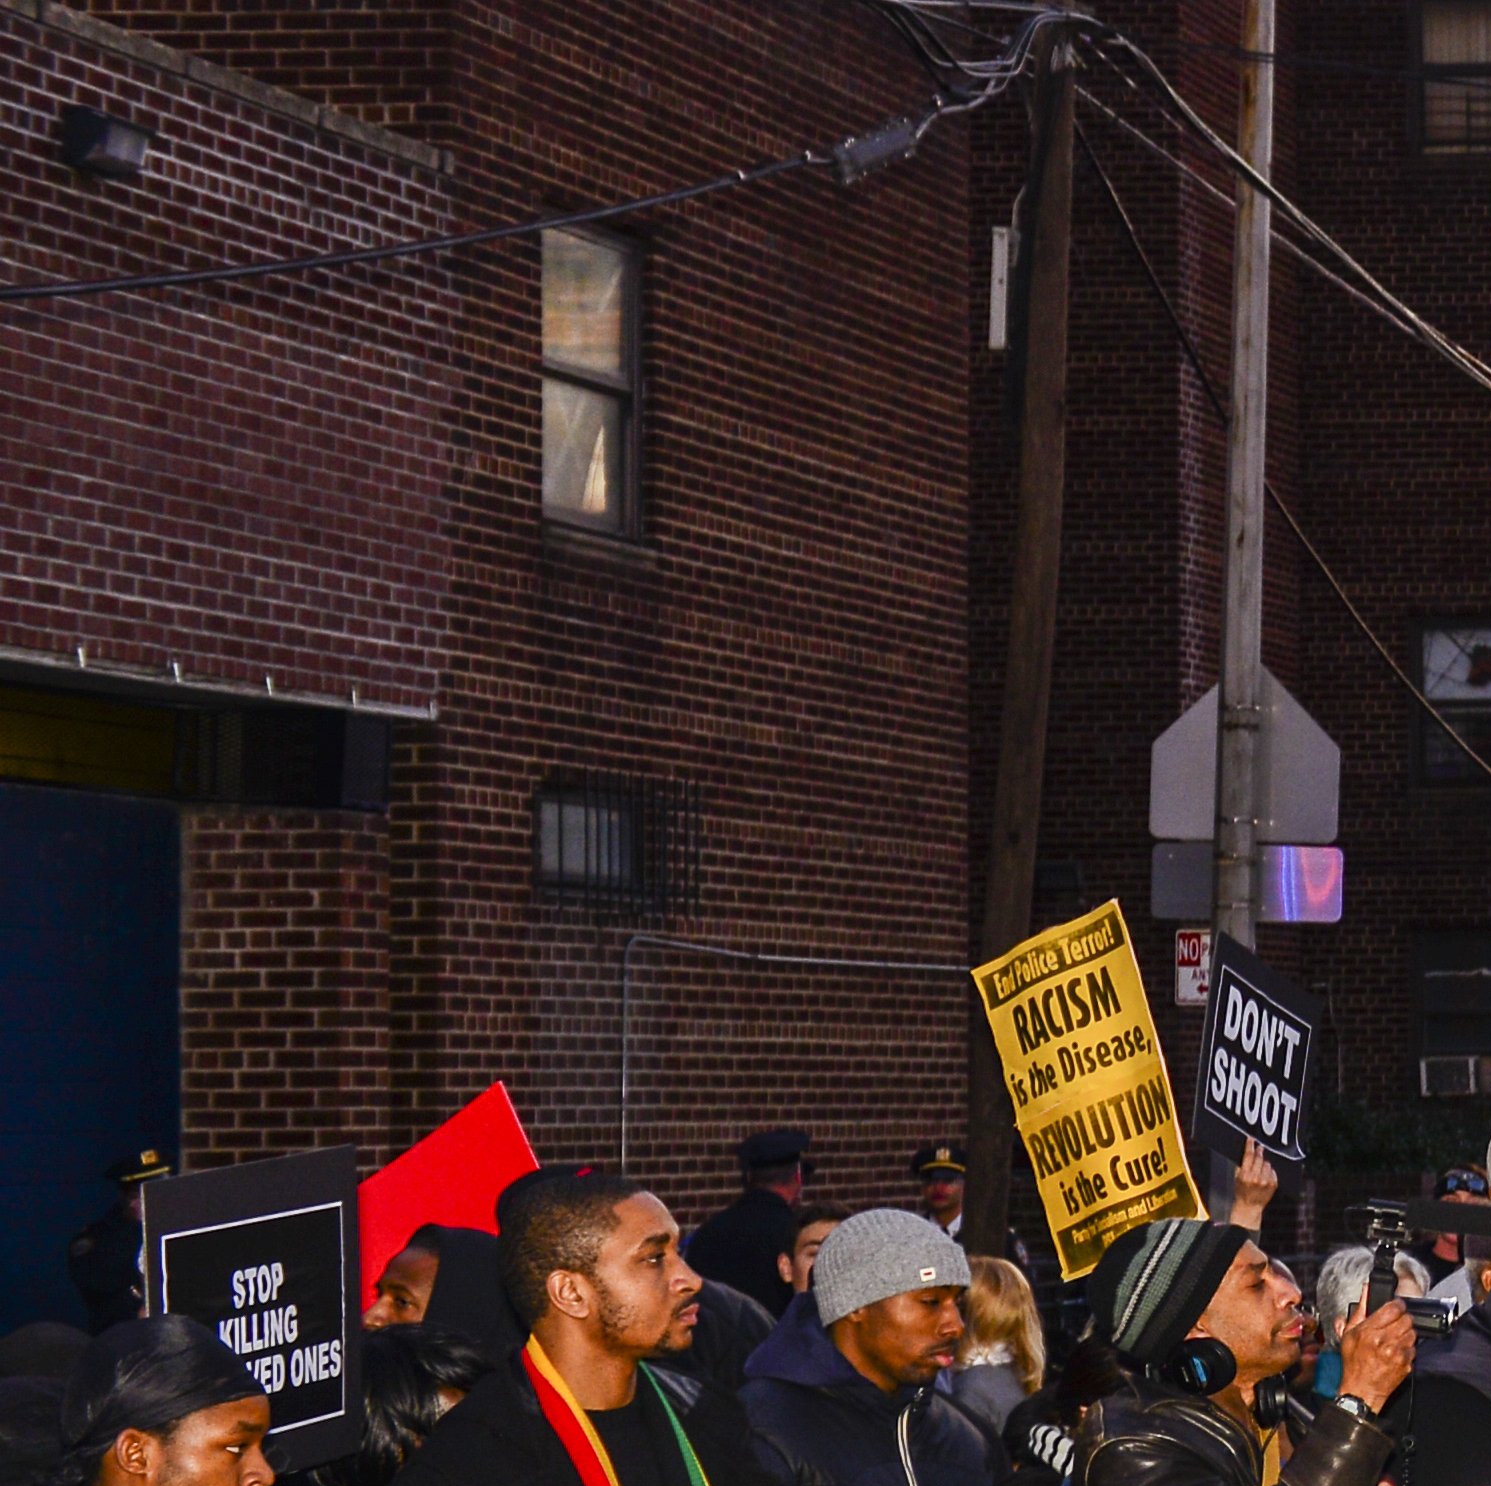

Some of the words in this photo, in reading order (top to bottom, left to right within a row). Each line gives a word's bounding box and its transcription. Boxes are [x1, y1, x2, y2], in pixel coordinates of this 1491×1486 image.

[1015, 949, 1059, 987] Police
[1058, 918, 1115, 965] Terror!
[1178, 937, 1199, 963] NO
[1012, 965, 1122, 1056] RACISM
[1224, 984, 1300, 1079] DON'T
[1010, 1073, 1027, 1108] is
[1028, 1061, 1058, 1099] the
[1056, 1025, 1152, 1083] Disease,
[1211, 1046, 1297, 1145] SHOOT
[1028, 1074, 1171, 1180] REVOLUTION
[1059, 1181, 1079, 1217] is
[1076, 1170, 1108, 1209] the
[1109, 1136, 1169, 1192] Cure!
[232, 1262, 284, 1310] STOP
[219, 1304, 299, 1355] KILLING
[245, 1353, 286, 1394] VED
[291, 1338, 342, 1388] ONES
